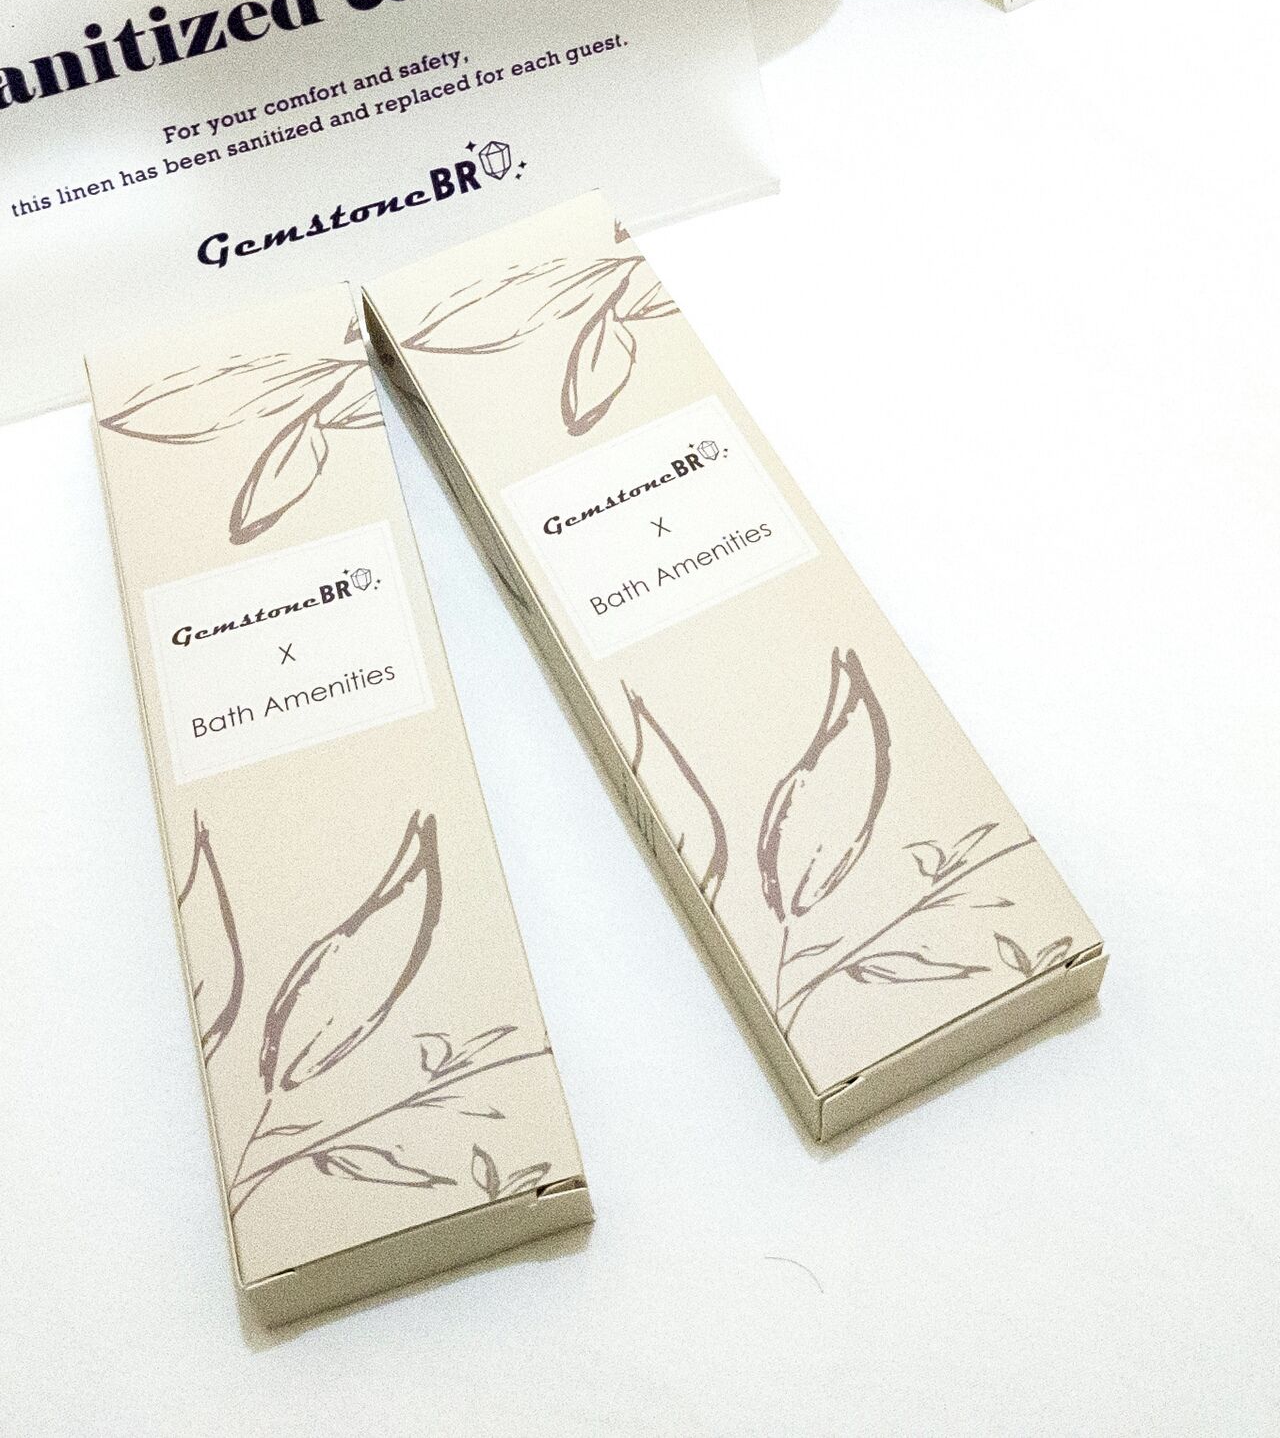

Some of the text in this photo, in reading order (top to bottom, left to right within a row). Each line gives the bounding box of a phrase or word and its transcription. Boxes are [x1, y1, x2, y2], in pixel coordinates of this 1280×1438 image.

[11, 34, 629, 217] this linen has been sanitized and replaced for each guest.
[162, 50, 469, 144] For your comfort and safety,
[198, 160, 482, 268] GemstoneBR
[543, 453, 704, 535] GemstoneBR
[650, 517, 672, 538] X
[589, 518, 773, 617] Bath Amenities
[171, 578, 352, 648] GemstoneBR
[278, 643, 297, 666] X
[191, 662, 396, 739] Bath Amenities
